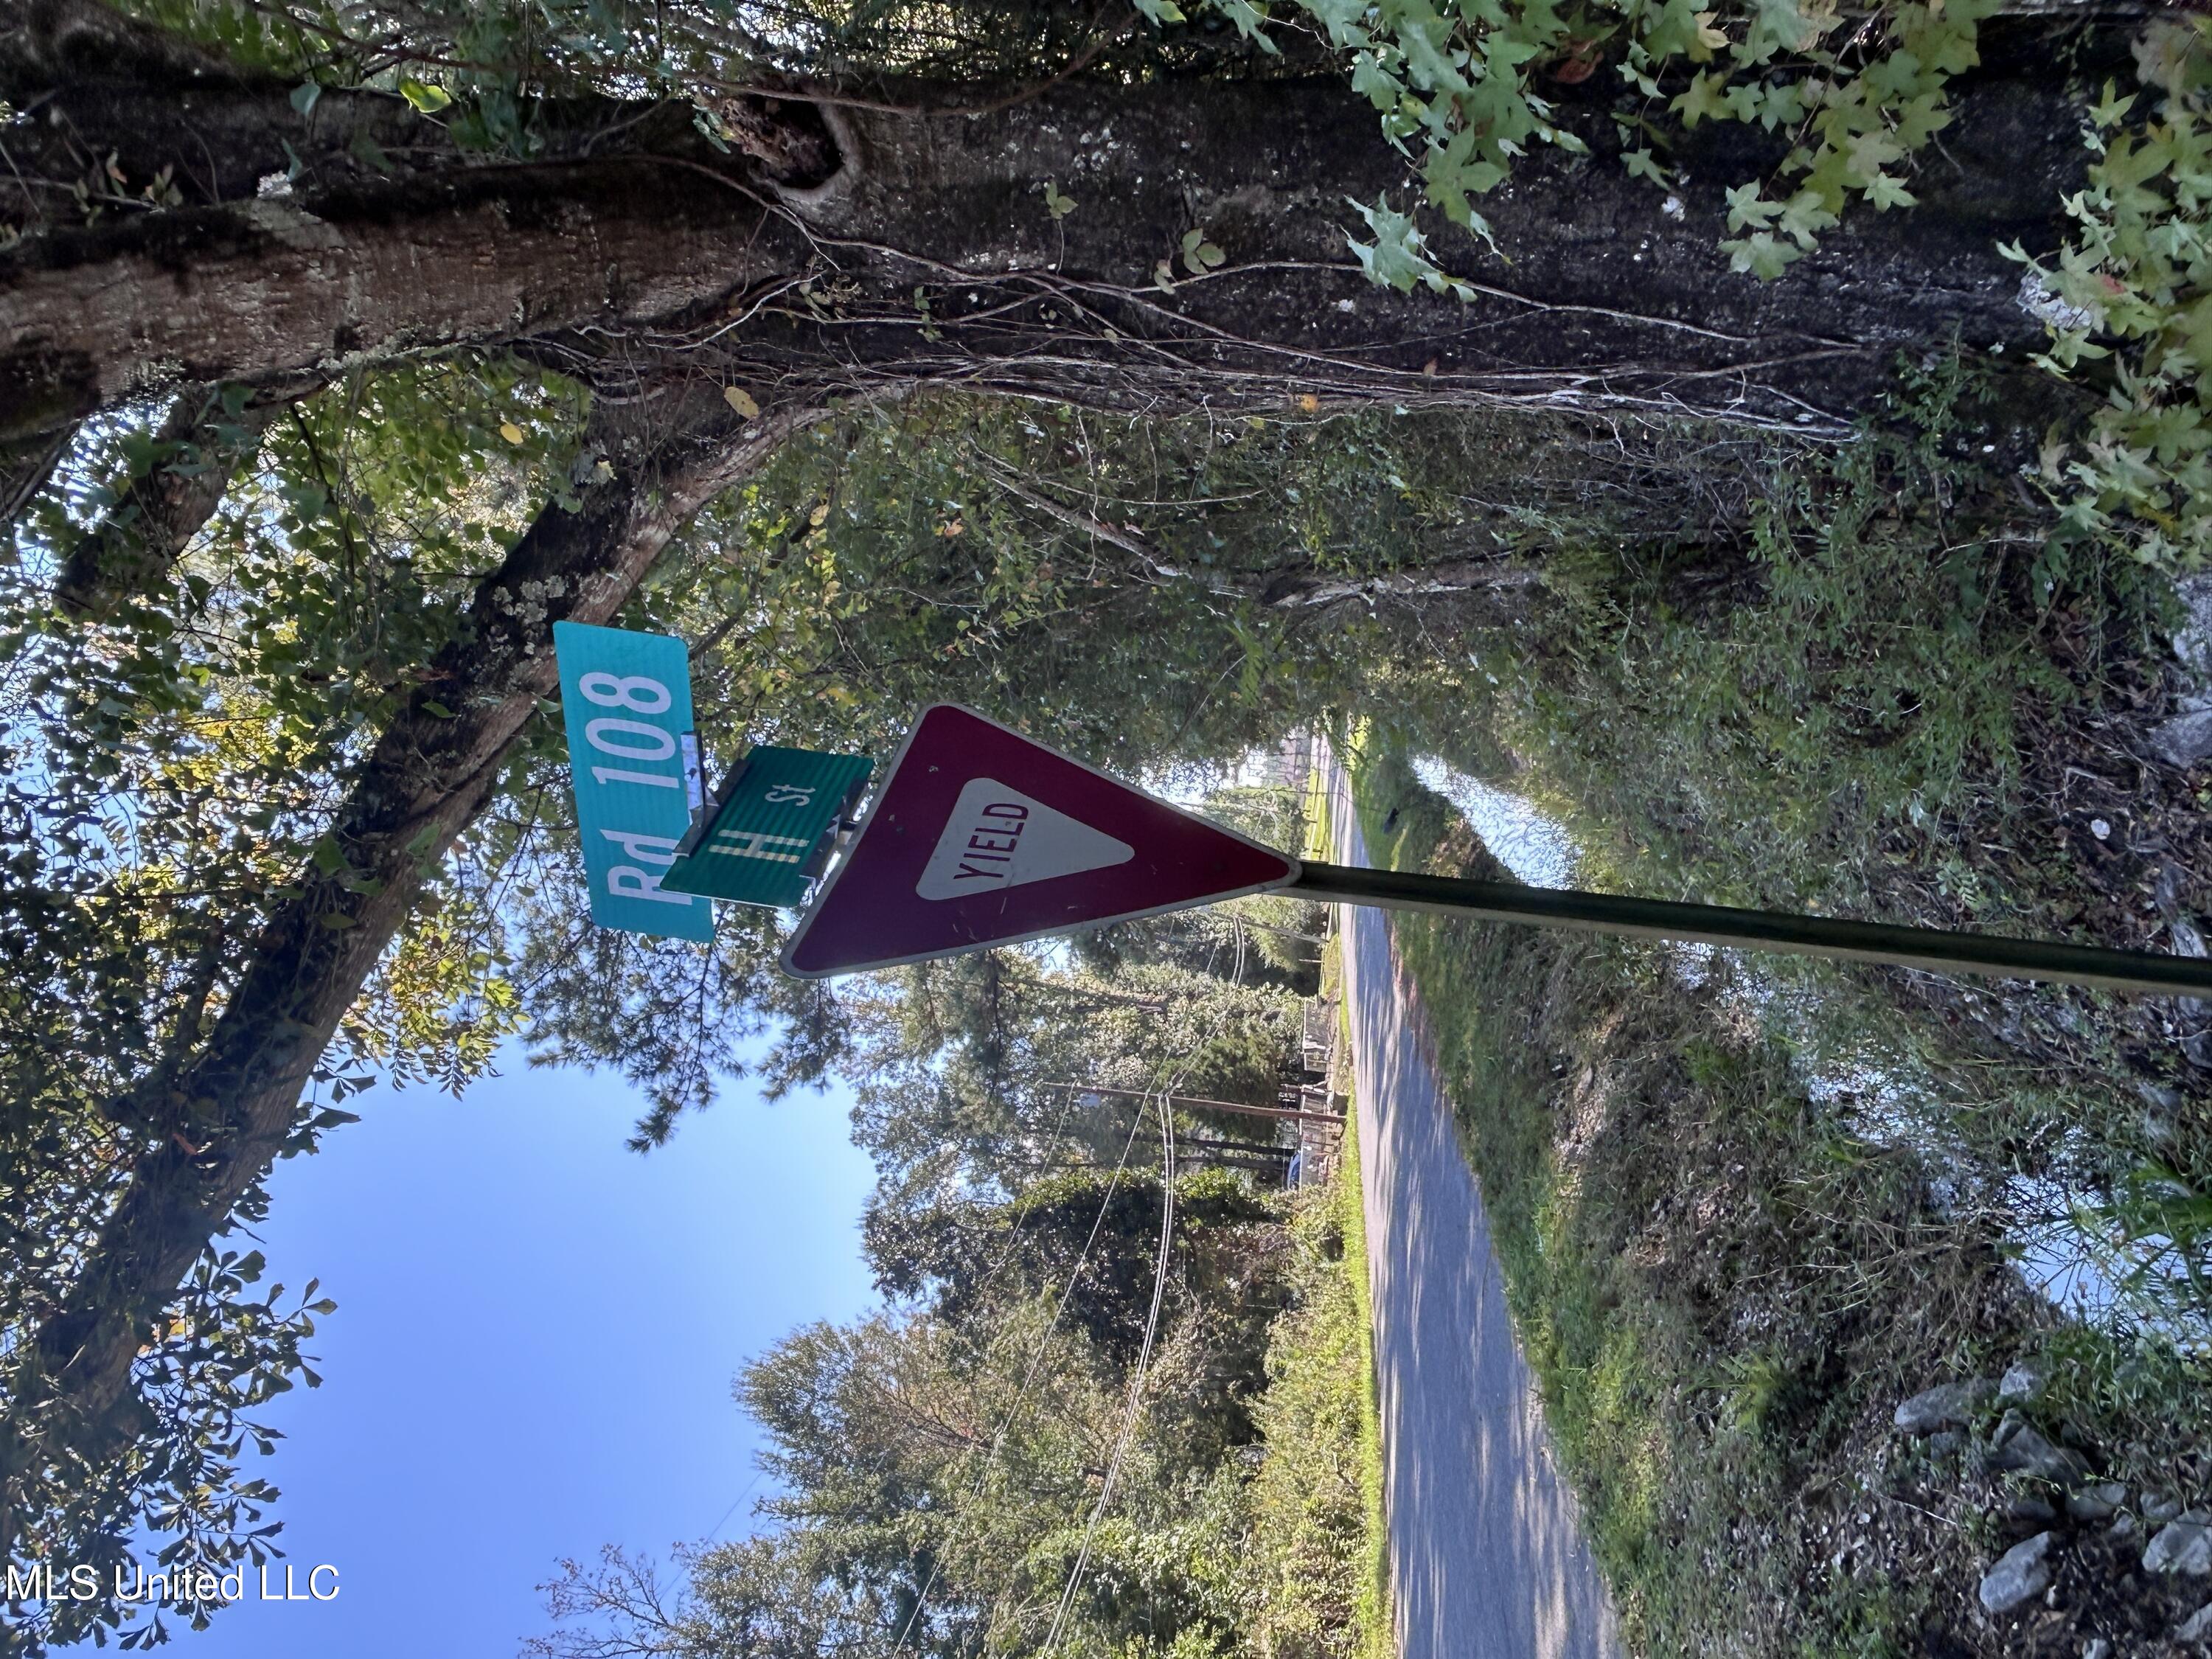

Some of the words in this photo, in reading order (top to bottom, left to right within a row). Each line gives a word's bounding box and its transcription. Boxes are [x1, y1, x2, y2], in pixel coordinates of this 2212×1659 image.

[579, 672, 679, 788] 108
[709, 830, 810, 863] H
[765, 784, 815, 807] St
[953, 803, 1029, 879] YIELD
[600, 830, 692, 905] Rd
